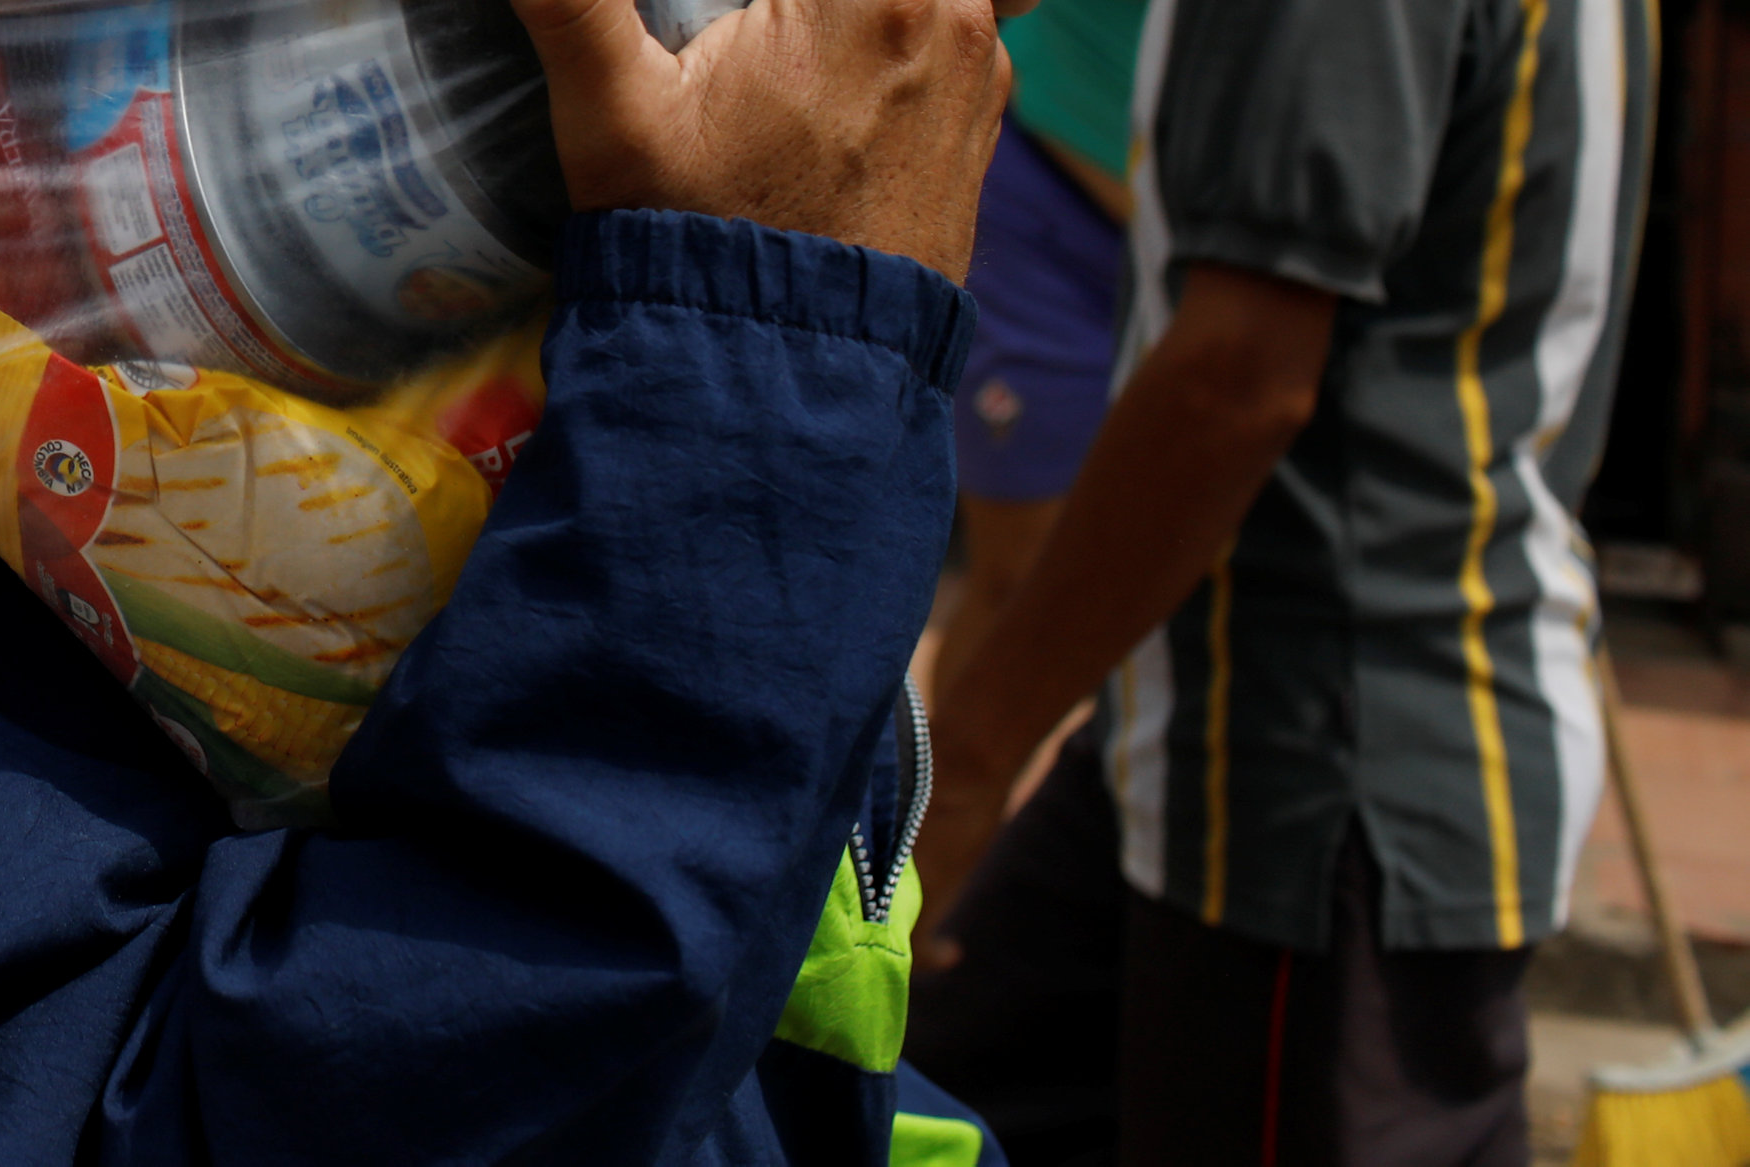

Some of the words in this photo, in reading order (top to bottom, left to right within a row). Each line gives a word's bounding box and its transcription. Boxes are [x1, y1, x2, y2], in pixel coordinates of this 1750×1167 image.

[33, 441, 63, 489] COLOMBIA
[346, 426, 381, 456] Imagen
[380, 451, 419, 495] ilustrativa
